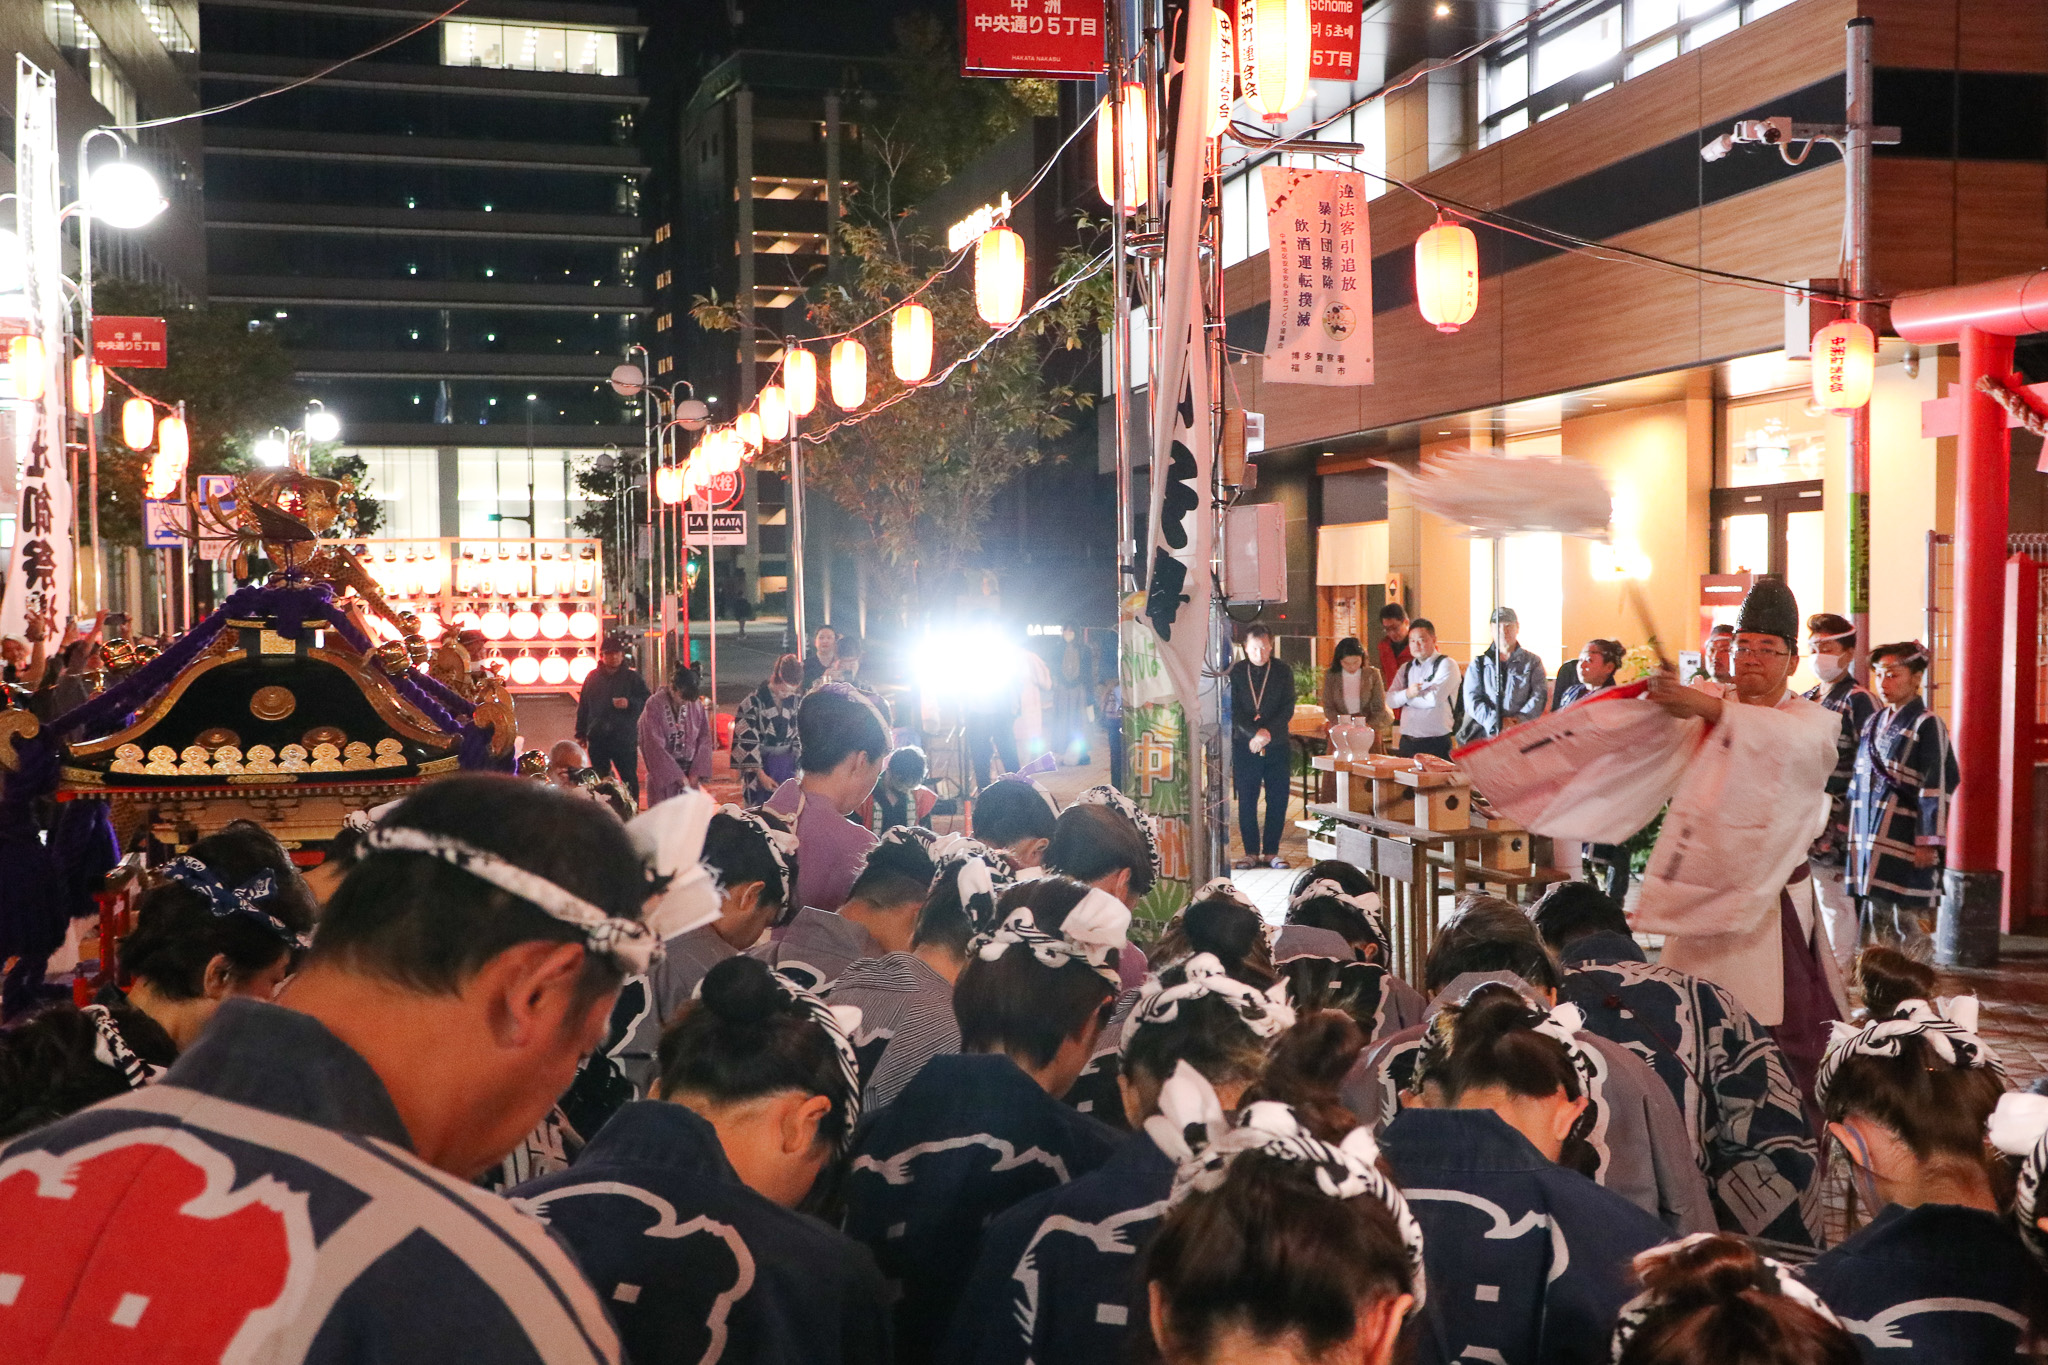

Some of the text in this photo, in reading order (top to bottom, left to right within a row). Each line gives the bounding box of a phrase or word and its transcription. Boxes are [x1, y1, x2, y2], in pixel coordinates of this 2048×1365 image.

[1010, 0, 1061, 14] 中洲
[1311, 0, 1353, 13] 5chome
[975, 14, 1096, 36] 中央通り5丁目
[1313, 50, 1352, 67] 5丁目
[1318, 201, 1334, 290] 暴力団排除
[1339, 184, 1357, 292] 違法客引追放
[1294, 218, 1312, 327] 飲酒運転撲滅
[1291, 352, 1345, 363] 博多警察署
[1291, 364, 1345, 375] 福岡市
[697, 474, 733, 491] 火栓
[689, 516, 704, 526] LA
